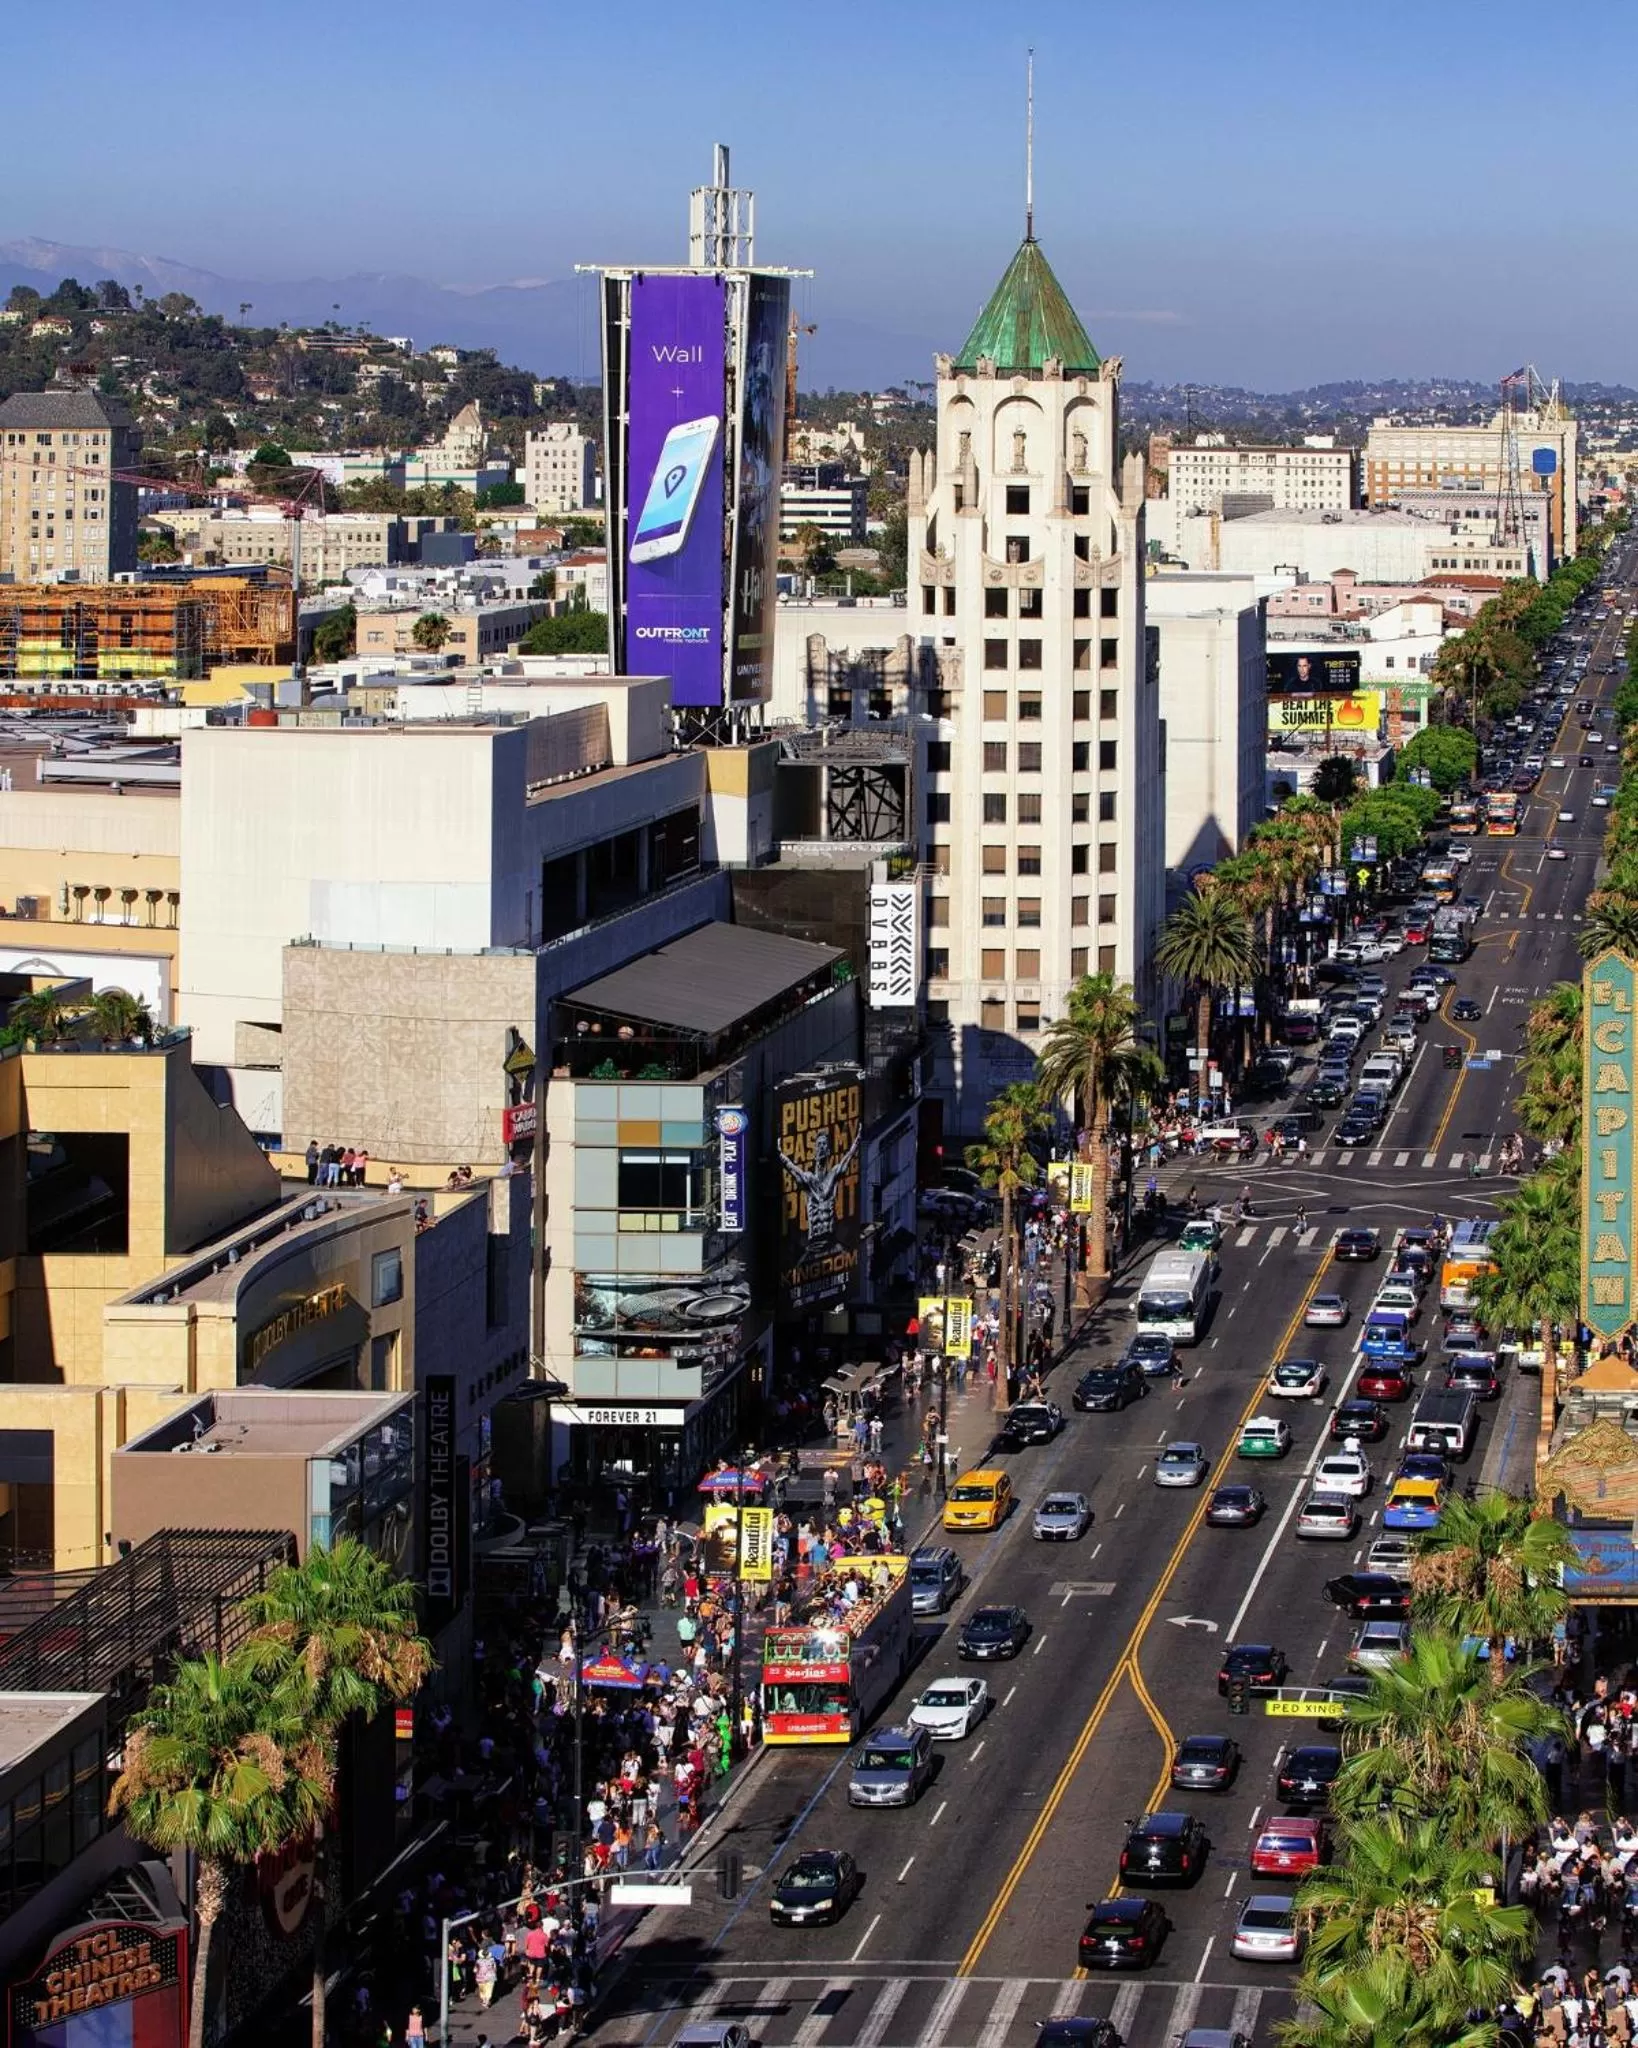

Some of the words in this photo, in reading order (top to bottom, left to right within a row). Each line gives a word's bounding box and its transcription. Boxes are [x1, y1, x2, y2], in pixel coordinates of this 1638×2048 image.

[652, 345, 702, 363] Wall
[636, 627, 710, 638] OUTFRONT
[1281, 711, 1334, 726] SUMMER
[1282, 700, 1309, 711] BEAT
[1592, 980, 1632, 1014] EL
[782, 1085, 859, 1137] PUSHED
[725, 1140, 738, 1162] PLAY
[1592, 1019, 1631, 1306] CAPITAN
[725, 1173, 738, 1200] DRINK
[725, 1211, 738, 1228] EAT
[781, 1248, 859, 1287] KINGDOM
[948, 1302, 963, 1348] Beautiful
[588, 1411, 640, 1423] FOREVER
[645, 1411, 658, 1423] 21
[430, 1391, 449, 1489] THEATRE
[430, 1492, 449, 1564] DOLBY
[744, 1512, 761, 1569] Beautiful
[1272, 1703, 1300, 1713] PED
[1305, 1704, 1337, 1714] XING
[74, 1929, 121, 1961] TCL
[46, 1942, 151, 1994] CHINESE
[33, 1962, 161, 2023] THEATRES
